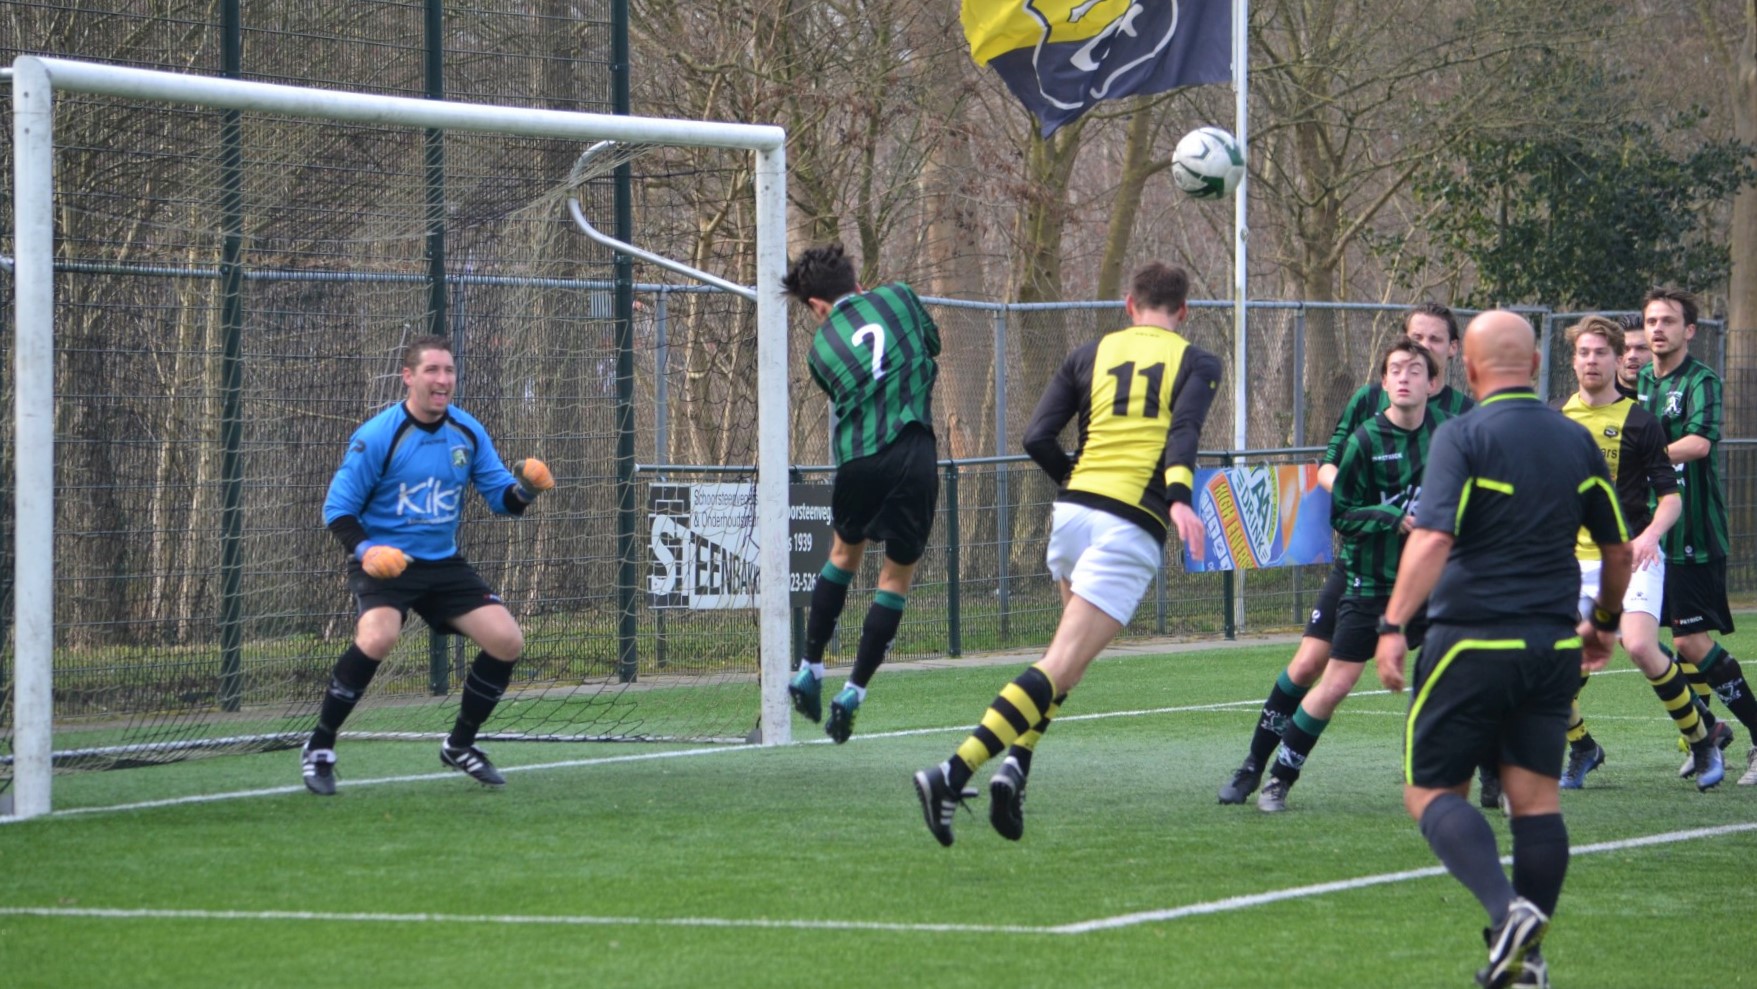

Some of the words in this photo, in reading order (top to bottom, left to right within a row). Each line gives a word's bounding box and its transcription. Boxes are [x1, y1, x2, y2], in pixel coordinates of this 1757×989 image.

[851, 323, 887, 380] 7
[1107, 360, 1166, 419] 11
[1214, 482, 1236, 520] HIGH
[1241, 485, 1265, 555] DRINK
[794, 532, 813, 552] 1939
